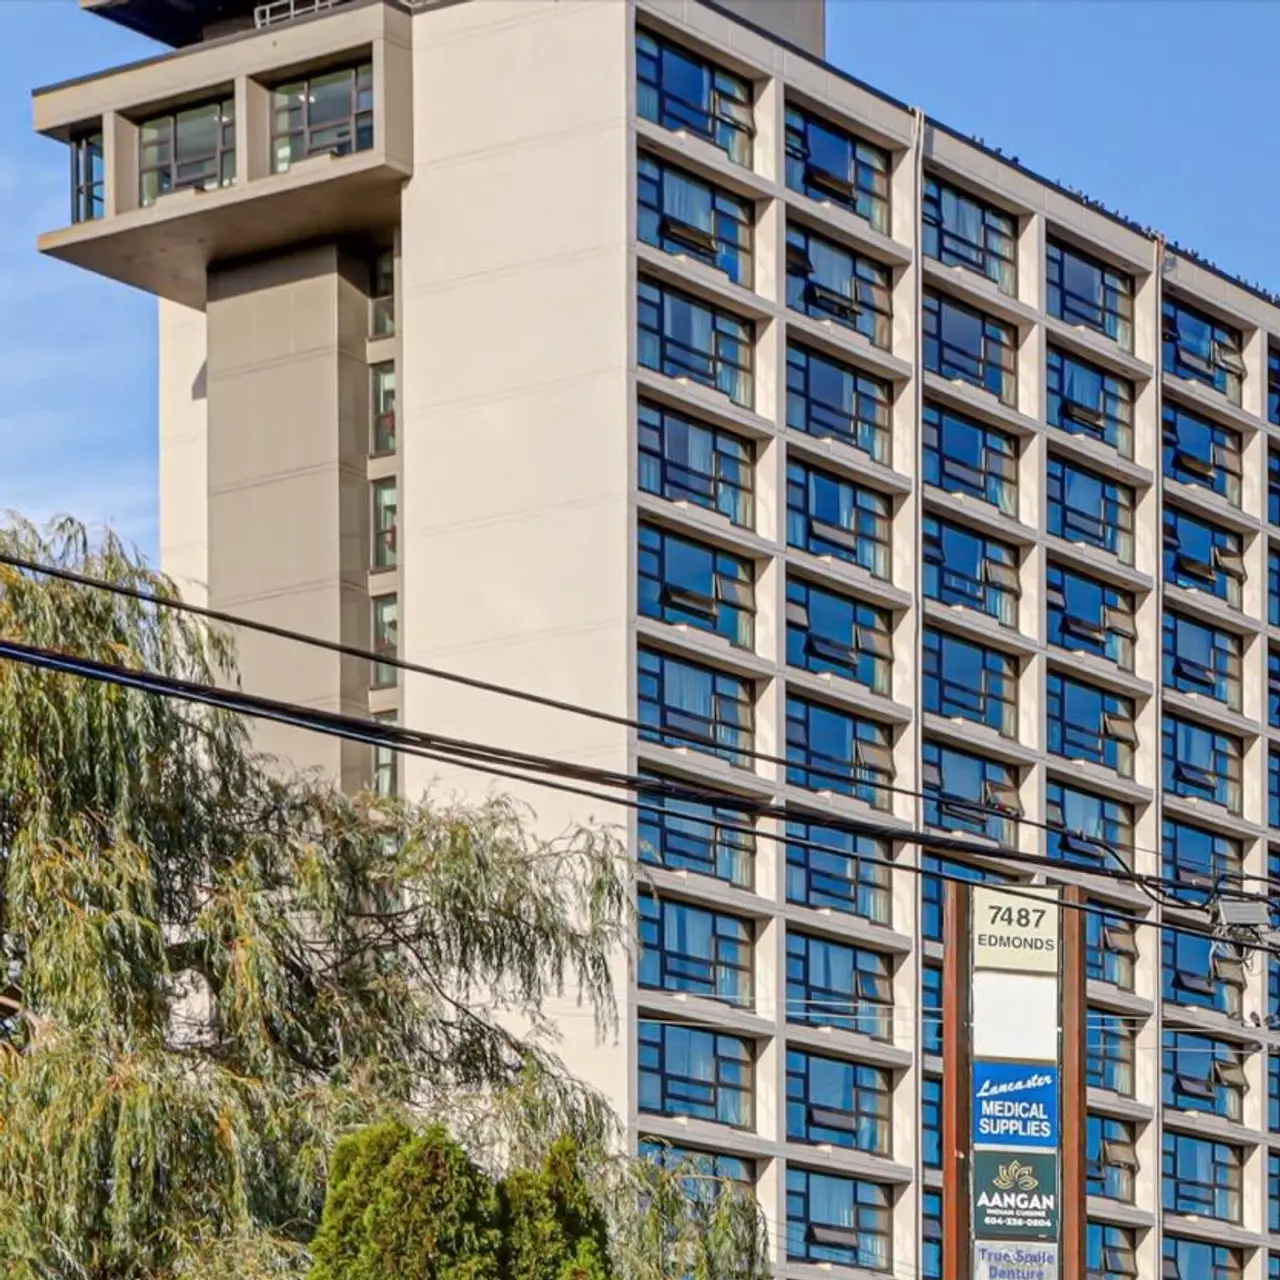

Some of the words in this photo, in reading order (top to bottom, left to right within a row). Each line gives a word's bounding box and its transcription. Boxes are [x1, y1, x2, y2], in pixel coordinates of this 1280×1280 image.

[988, 906, 1046, 928] 7487
[977, 934, 1055, 951] EDMONDS
[976, 1075, 1053, 1098] Lancaster
[981, 1101, 1048, 1119] MEDICAL
[979, 1118, 1051, 1138] SUPPLIES
[976, 1191, 1055, 1210] AANGAN
[979, 1248, 1011, 1262] True
[989, 1265, 1045, 1280] Denture
